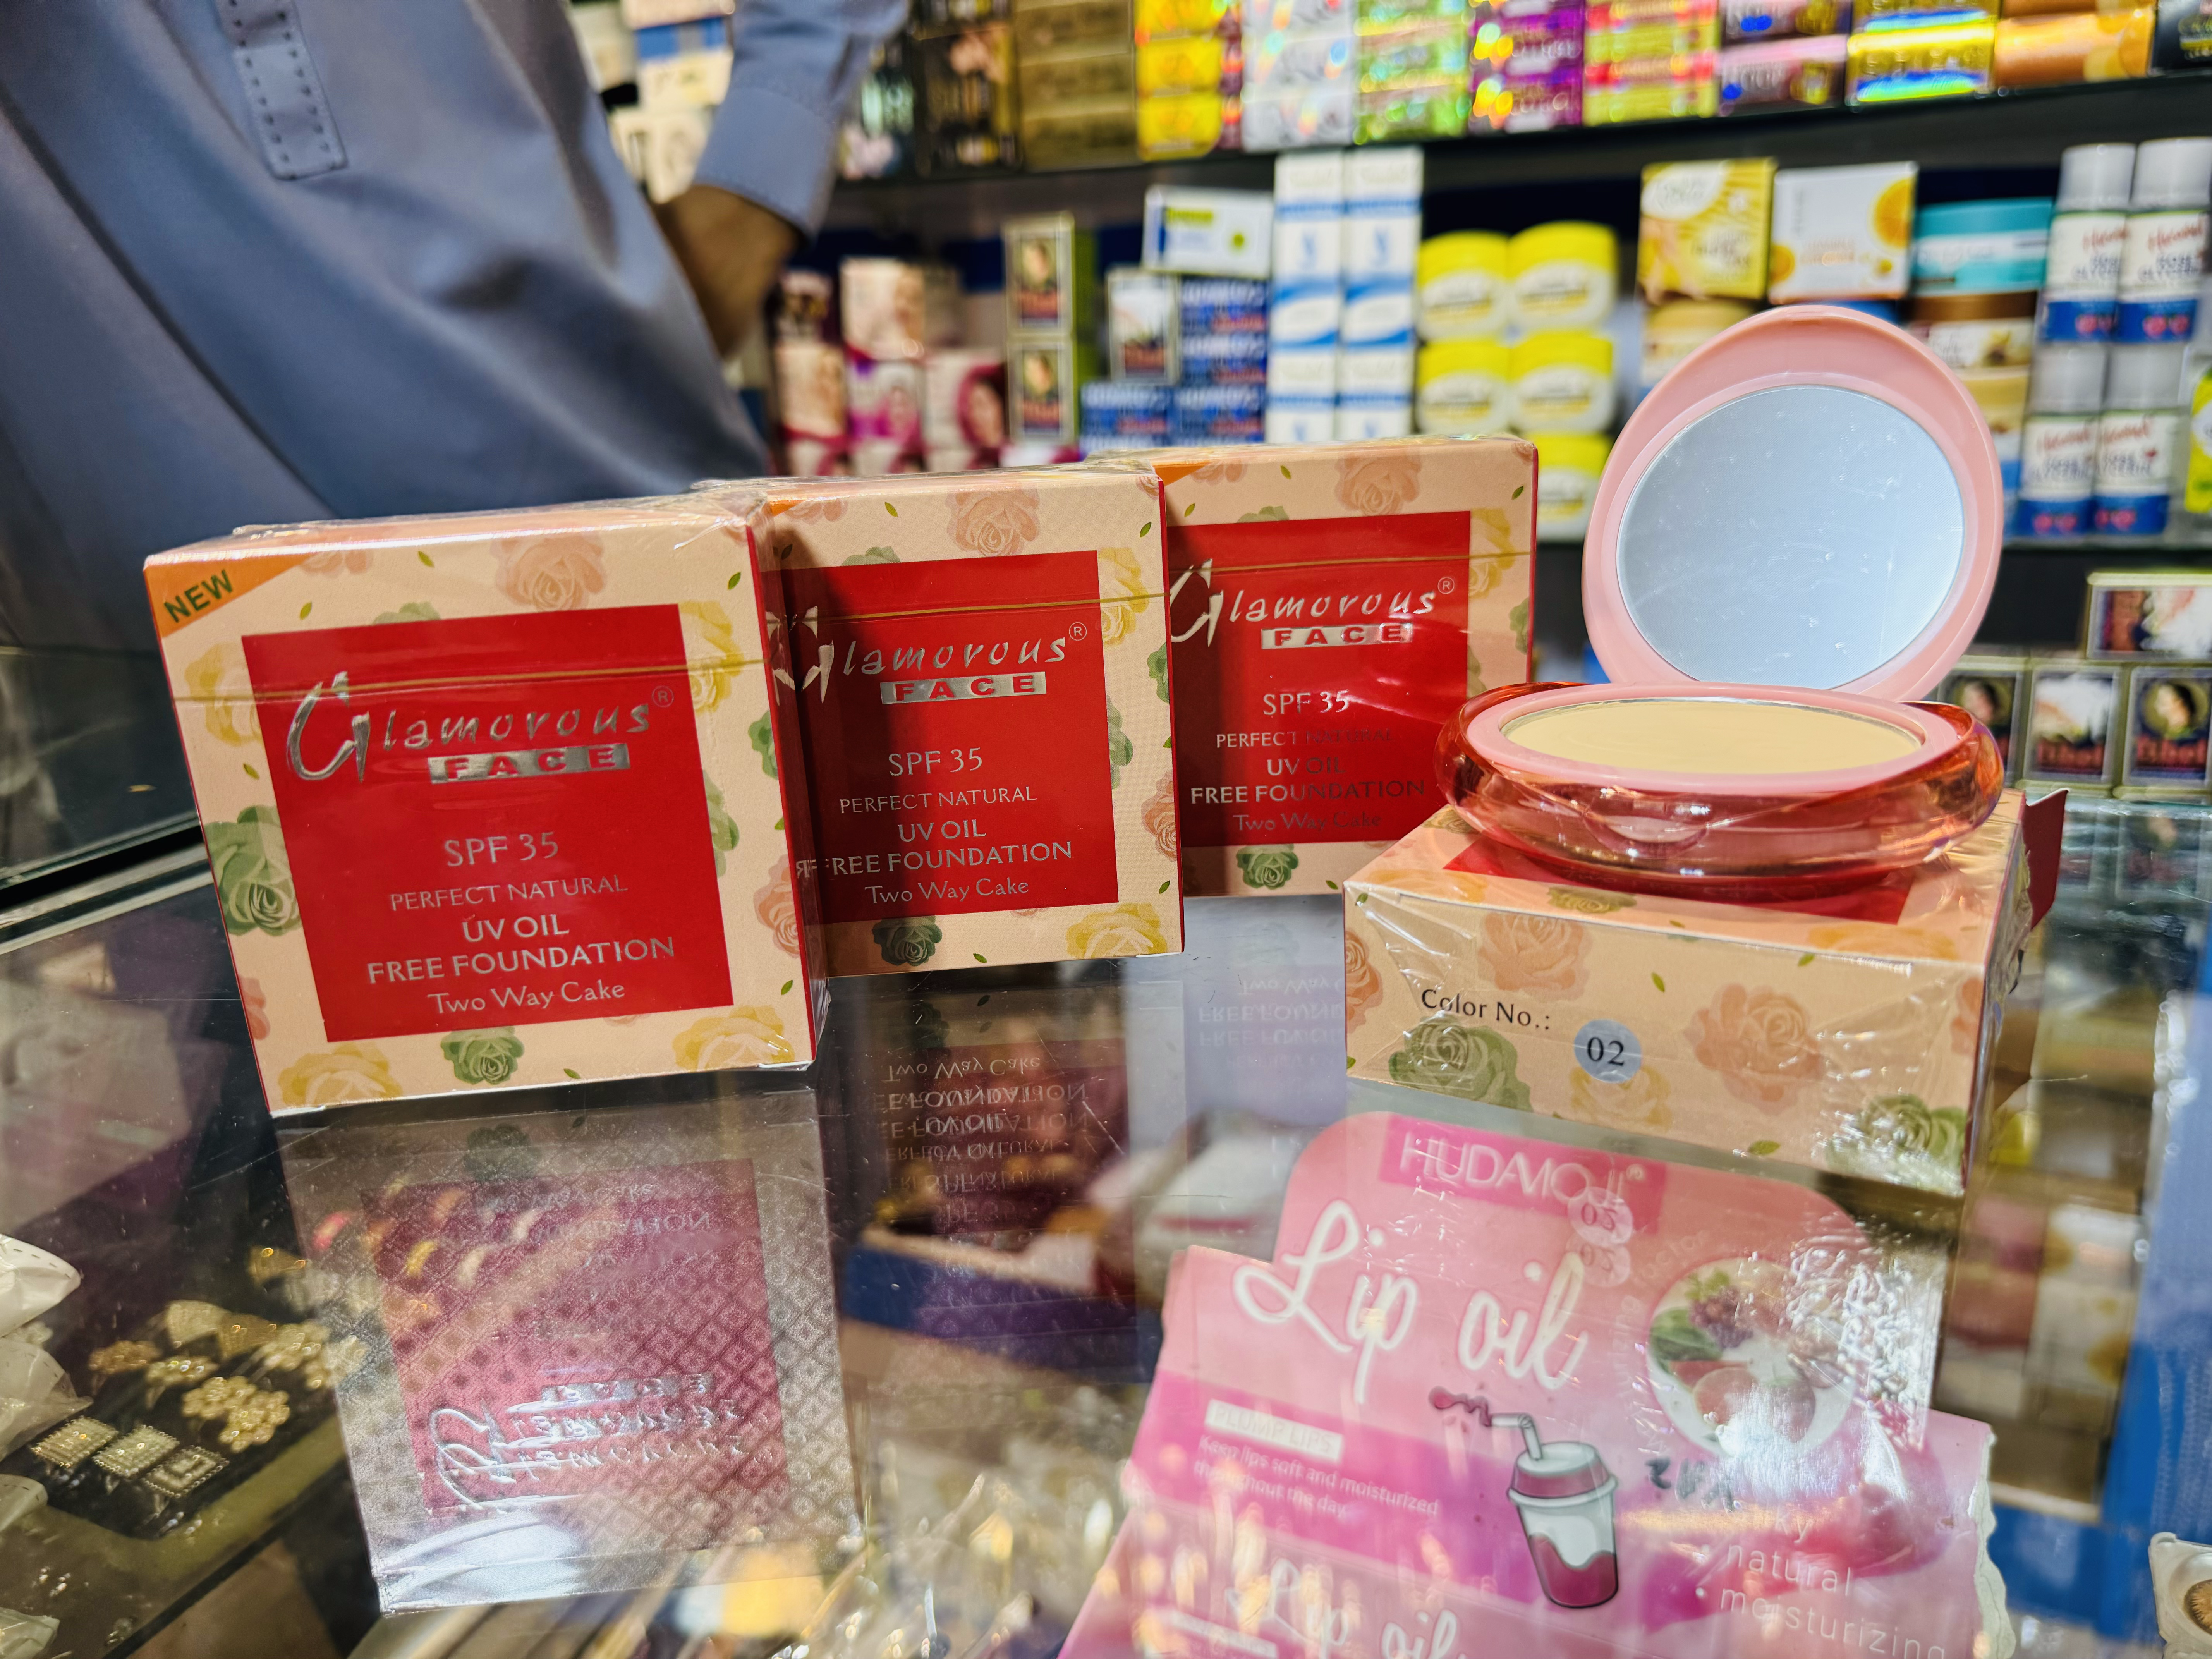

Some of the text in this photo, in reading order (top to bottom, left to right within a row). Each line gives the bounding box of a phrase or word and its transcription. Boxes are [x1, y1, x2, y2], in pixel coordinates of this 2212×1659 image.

[164, 569, 233, 623] NEW
[1169, 558, 1436, 647] Glamorous
[1274, 624, 1402, 647] FACE
[894, 675, 1034, 701] FACE
[1262, 689, 1350, 716] SPF 35
[287, 671, 649, 783] Glamorous
[1216, 728, 1393, 749] PERFECT NATURAL
[445, 744, 618, 781] FACE
[888, 747, 982, 776] SPF 35
[1266, 757, 1347, 776] UV OIL
[839, 786, 1037, 814] PERFECT NATURAL
[1190, 779, 1425, 805] FREE FOUNDATION
[898, 819, 987, 842] UV OIL
[1233, 811, 1382, 832] Two Way Cake
[444, 831, 559, 867] SPF 35
[888, 841, 1072, 871] FOUNDATION
[390, 874, 629, 911] PERFECT NATURAL
[864, 877, 1029, 904] Two Way Cake
[462, 914, 570, 943] UV OIL
[366, 936, 675, 984] FREE FOUNDATION
[428, 979, 626, 1014] Two Way Cake
[1421, 989, 1550, 1030] Color No.:
[1586, 1036, 1625, 1066] 02
[1233, 1199, 1419, 1405] Lip
[1458, 1251, 1589, 1391] oil
[1214, 1405, 1333, 1453] PLUMP LIPS
[1240, 1444, 1269, 1468] lips
[1273, 1458, 1305, 1478] soft
[1306, 1467, 1337, 1490] and
[1340, 1476, 1439, 1516] moisturized
[1726, 1544, 1852, 1596] natural
